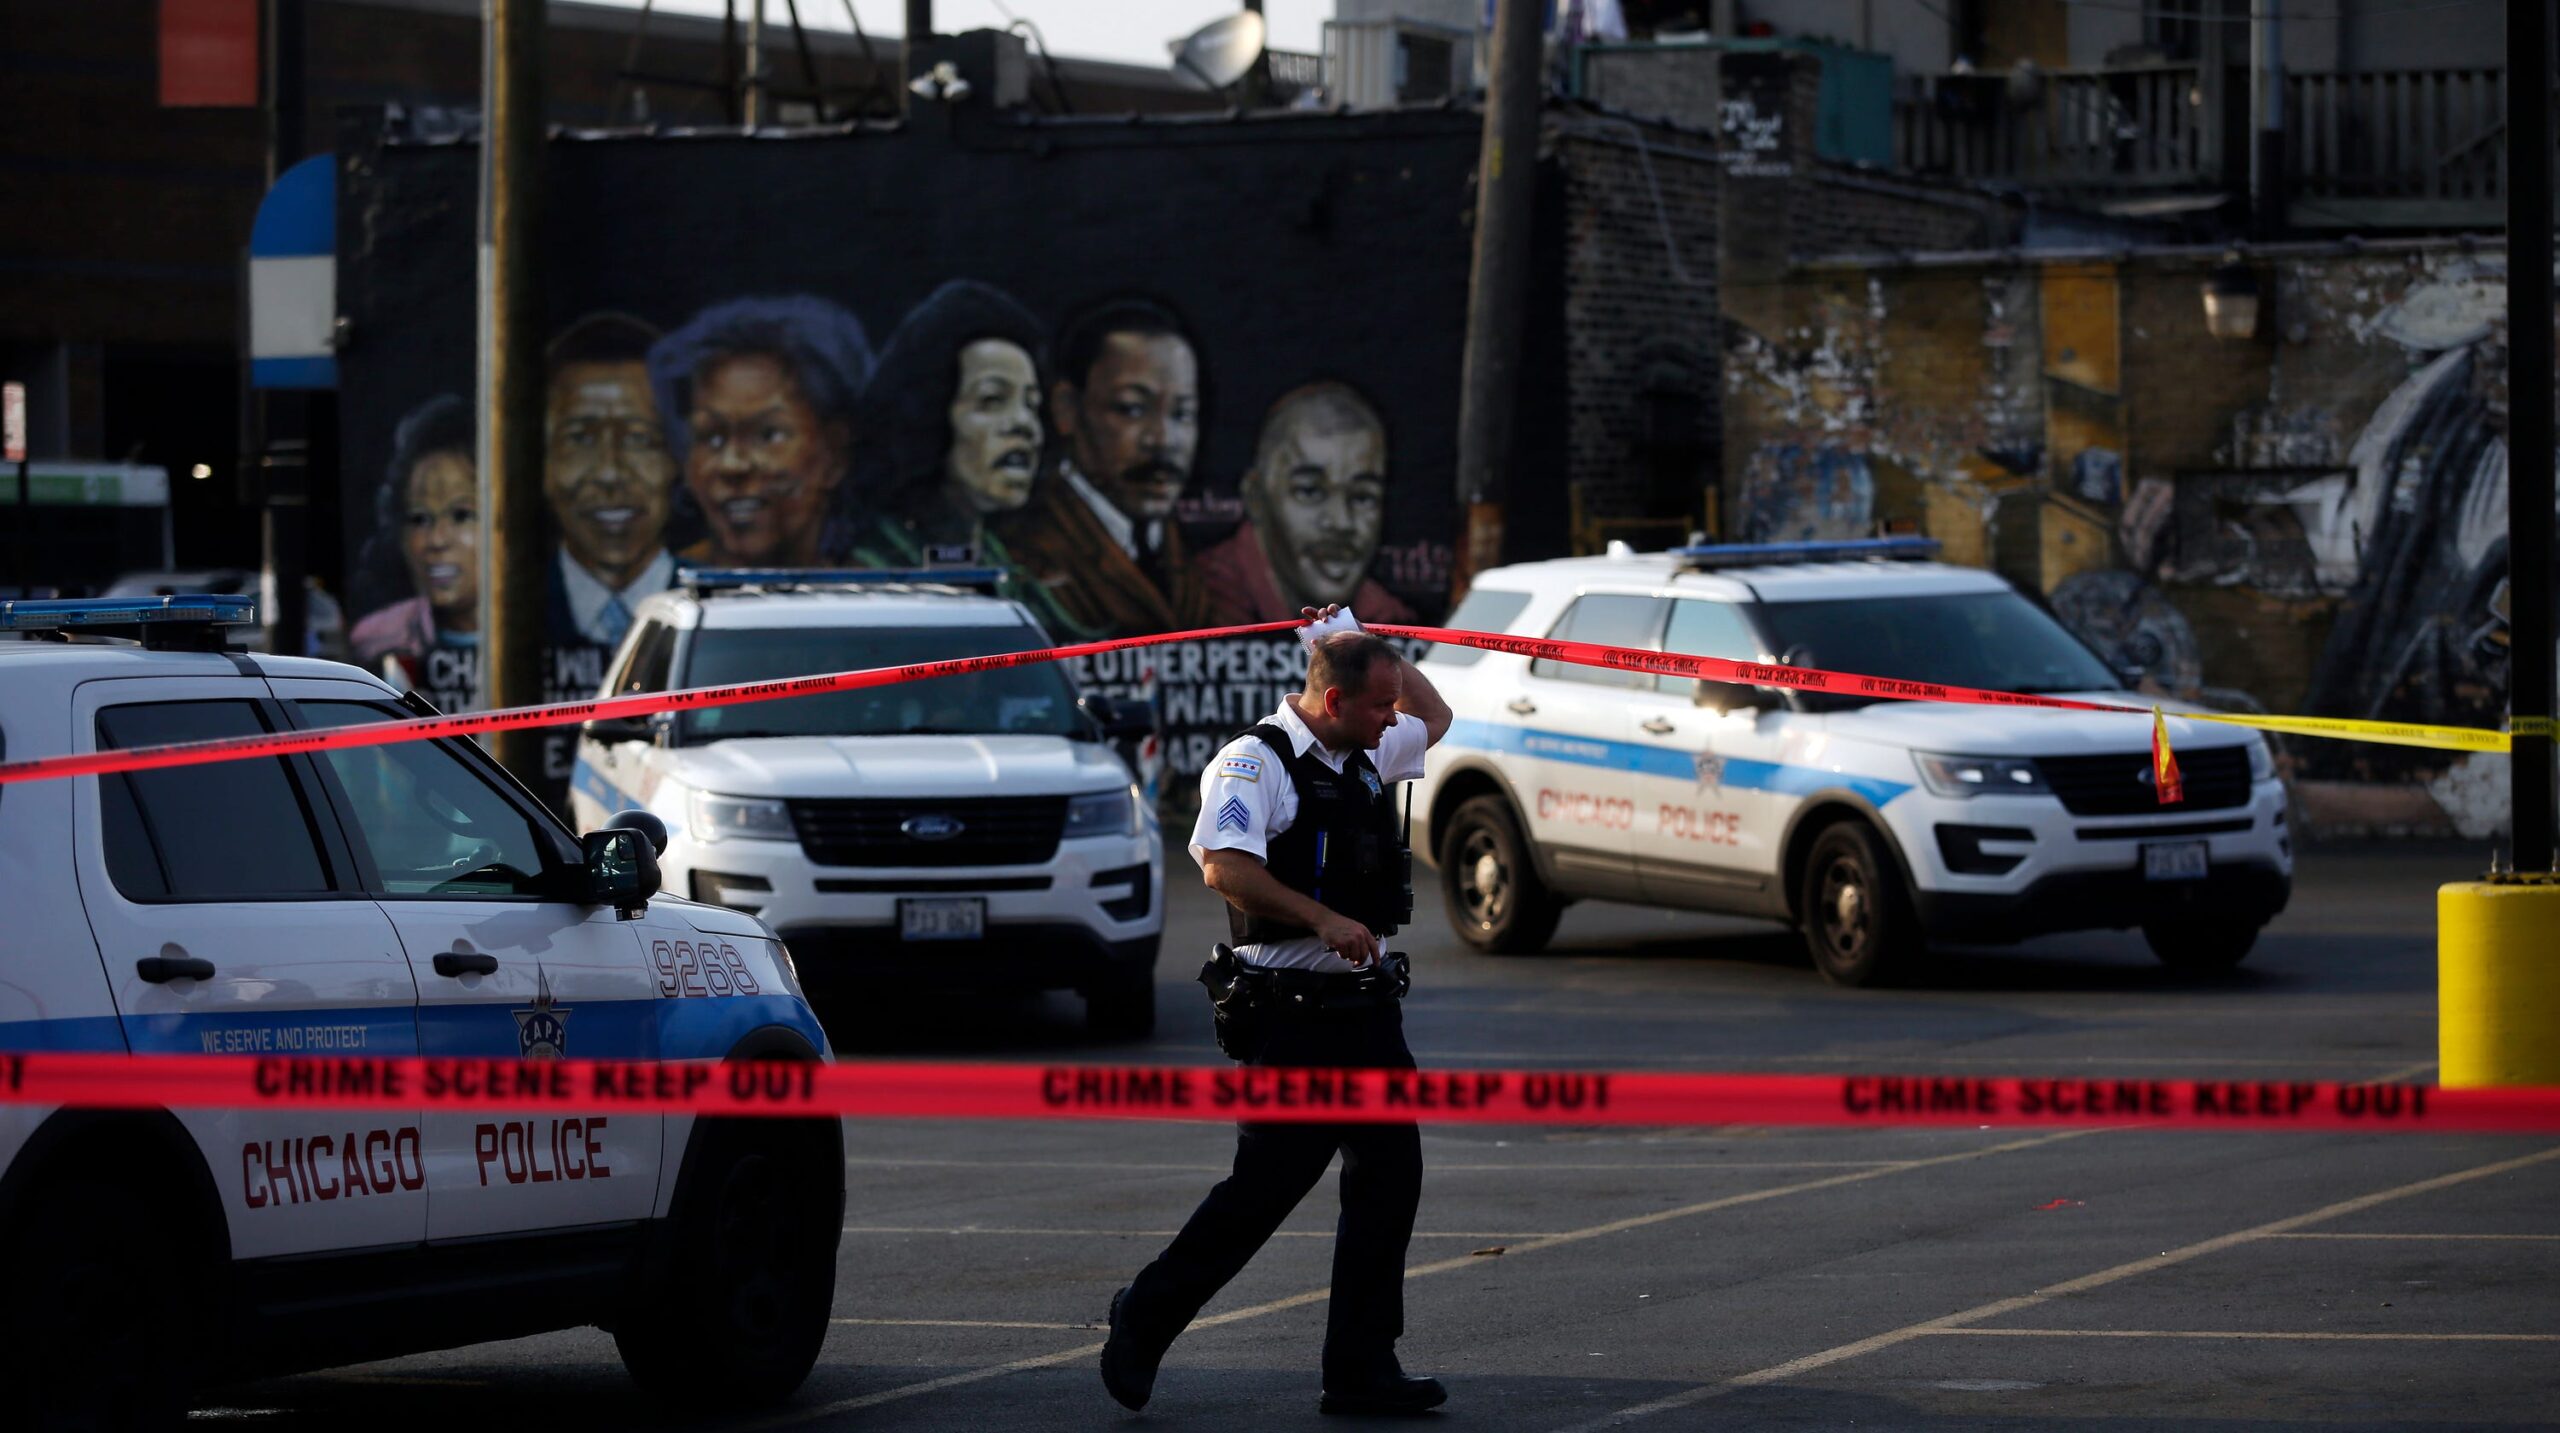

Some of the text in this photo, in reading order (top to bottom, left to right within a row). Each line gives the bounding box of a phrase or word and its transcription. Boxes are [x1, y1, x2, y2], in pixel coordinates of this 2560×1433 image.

[1537, 788, 1741, 847] CHICAGO POLICE
[652, 939, 760, 998] 9268
[202, 1026, 367, 1053] WE SERVE AND PROTECT
[523, 1022, 563, 1047] CAPS
[254, 1056, 405, 1097] CRIME
[423, 1059, 574, 1099] SCENE
[591, 1063, 709, 1100] KEEP
[729, 1065, 819, 1102] OUT
[1041, 1067, 1612, 1111] CRIME SCENE KEEP OUT
[1841, 1076, 2430, 1119] CRIME SCENE KEEP OUT
[242, 1116, 610, 1209] CHICAGO POLICE
